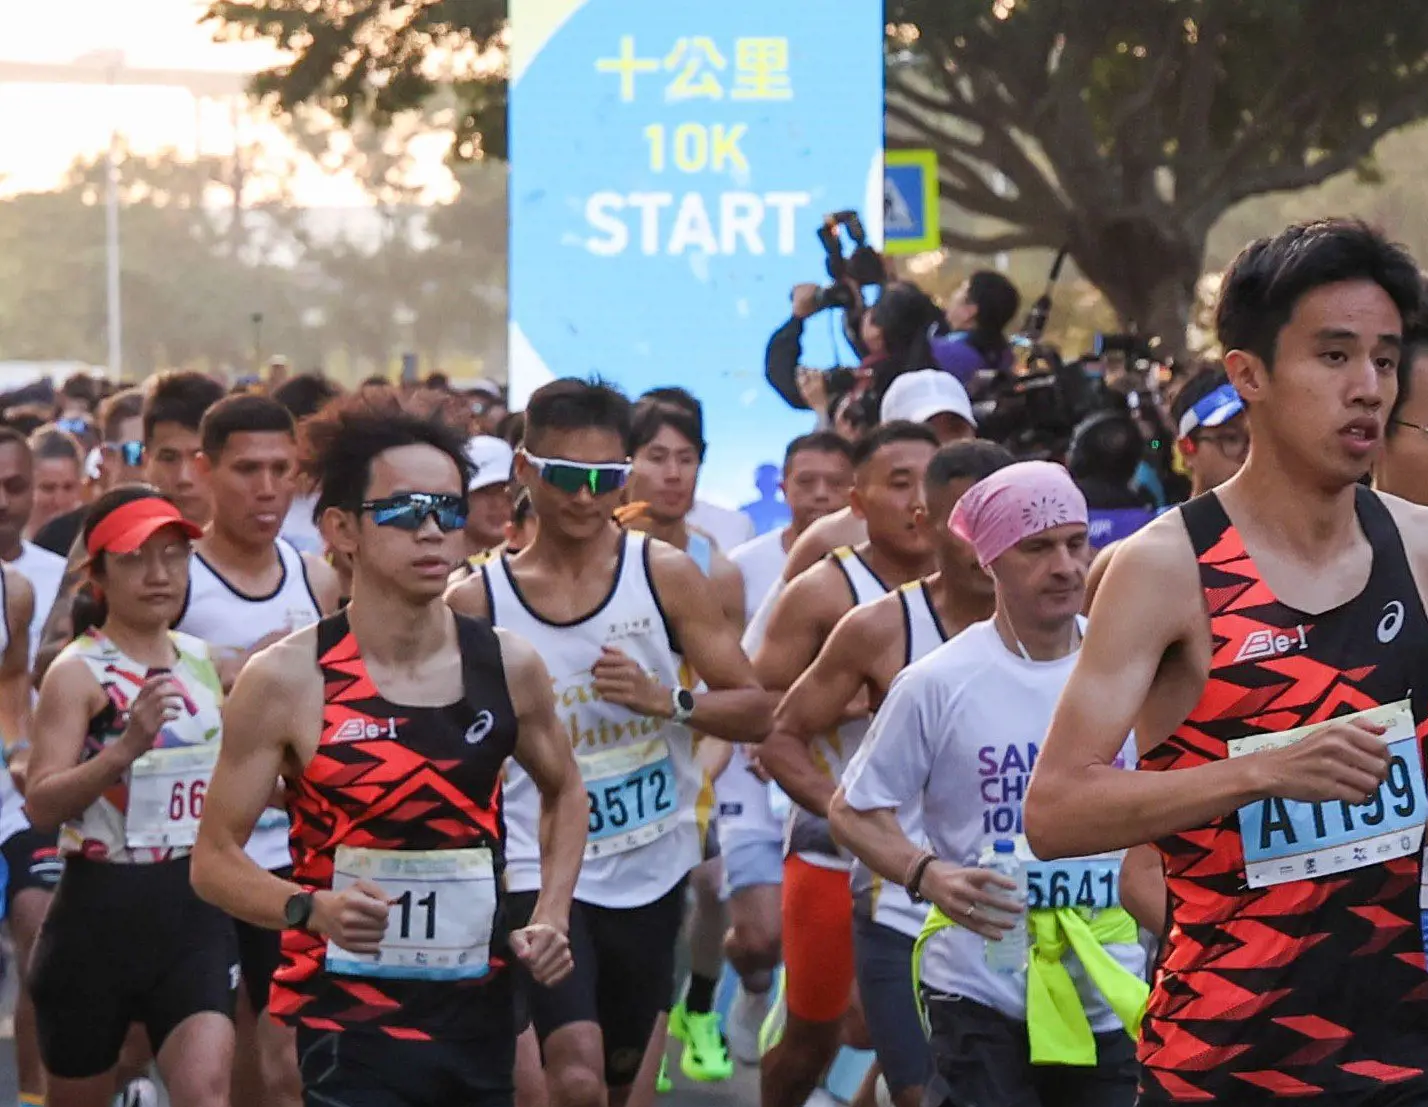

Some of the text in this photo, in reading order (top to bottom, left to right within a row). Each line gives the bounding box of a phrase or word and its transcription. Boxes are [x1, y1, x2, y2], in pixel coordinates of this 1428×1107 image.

[594, 34, 794, 102] 十公里
[644, 121, 749, 173] 10K
[584, 191, 811, 256] START
[396, 890, 436, 940] 11
[1026, 869, 1114, 909] 5641
